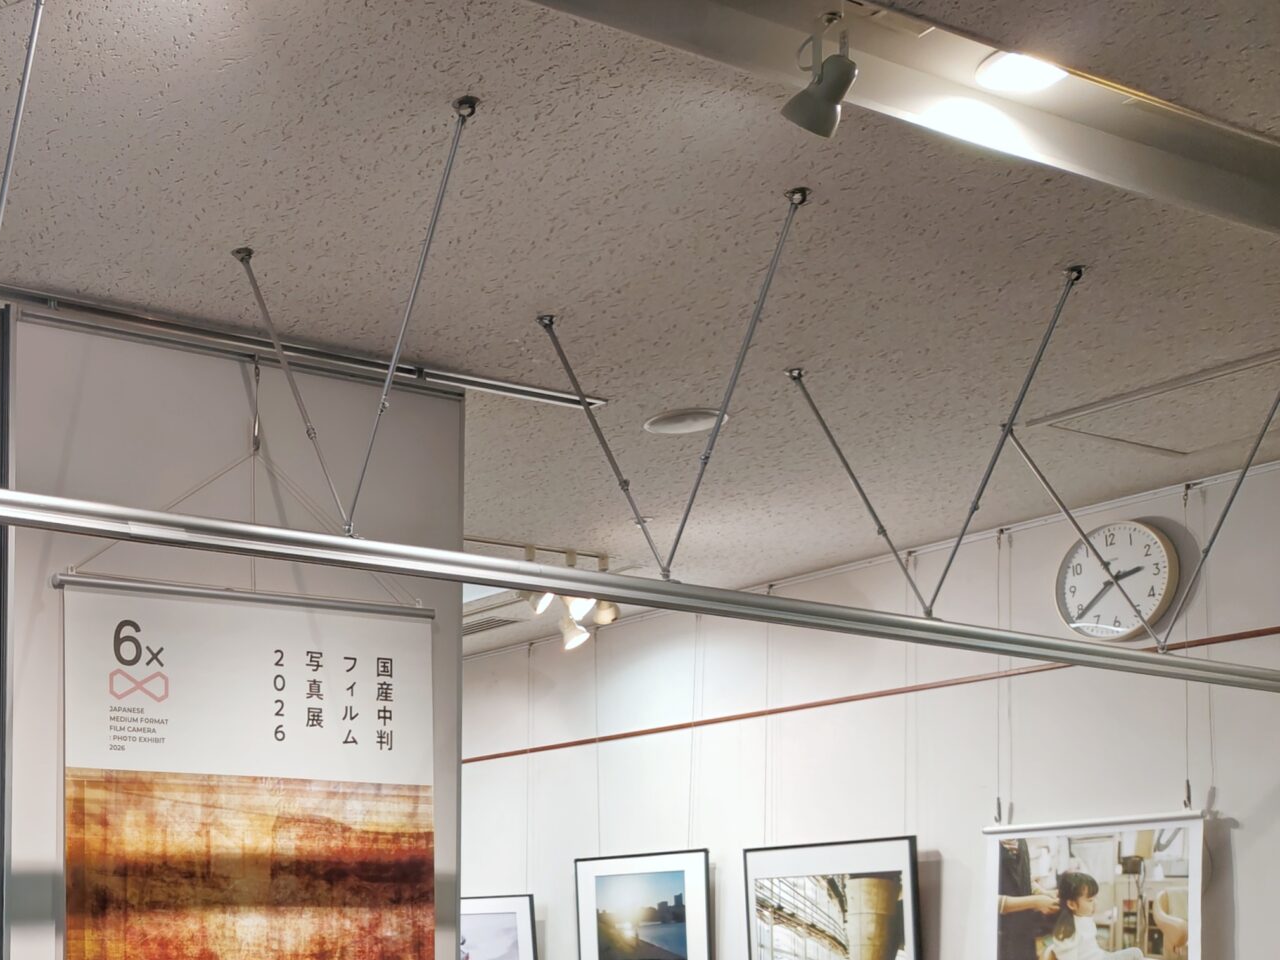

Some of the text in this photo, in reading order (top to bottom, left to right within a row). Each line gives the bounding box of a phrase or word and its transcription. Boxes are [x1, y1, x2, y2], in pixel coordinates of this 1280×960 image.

[1105, 532, 1116, 547] 12
[1129, 533, 1133, 546] 1
[1143, 543, 1152, 557] 2
[1071, 562, 1083, 577] 10
[1152, 562, 1161, 576] 3
[1069, 585, 1077, 598] 9
[1147, 585, 1156, 598] 4
[1093, 614, 1101, 626] 7
[1112, 615, 1122, 628] 6
[273, 649, 286, 742] 2026
[305, 650, 324, 729] 写真展
[341, 656, 359, 745] フィルム
[375, 656, 394, 751] 国産中判
[109, 705, 145, 715] JAPANESE
[109, 715, 169, 725] MEDIUM FORMAT
[127, 726, 157, 734] CAMERA
[112, 735, 138, 743] PHOTO
[138, 736, 166, 744] EXHIBIT
